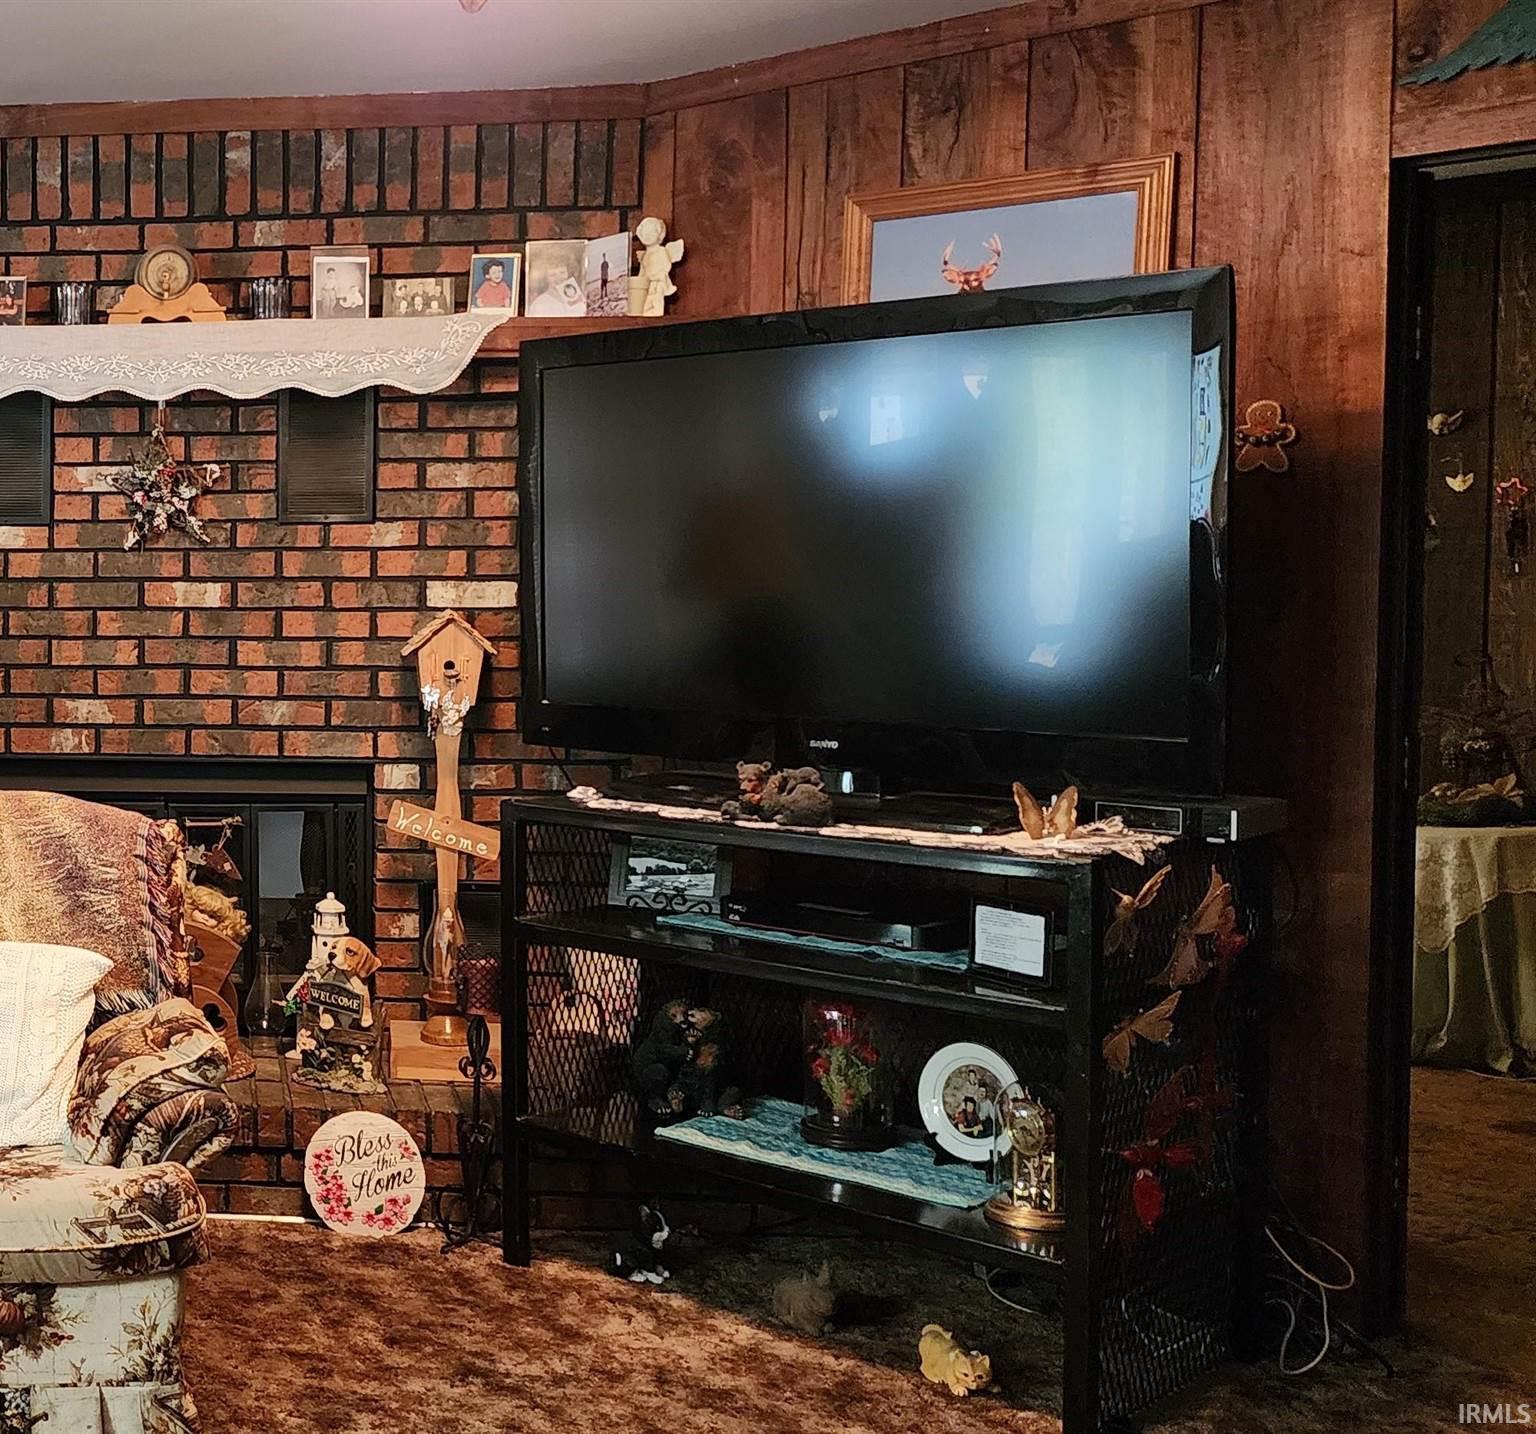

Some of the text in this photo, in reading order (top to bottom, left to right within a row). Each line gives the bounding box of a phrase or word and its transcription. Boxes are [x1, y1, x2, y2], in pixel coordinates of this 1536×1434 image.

[395, 806, 489, 855] Welcome
[311, 988, 360, 1010] WELCOME
[334, 1129, 392, 1168] Bless
[372, 1153, 398, 1173] this
[351, 1167, 417, 1203] Home
